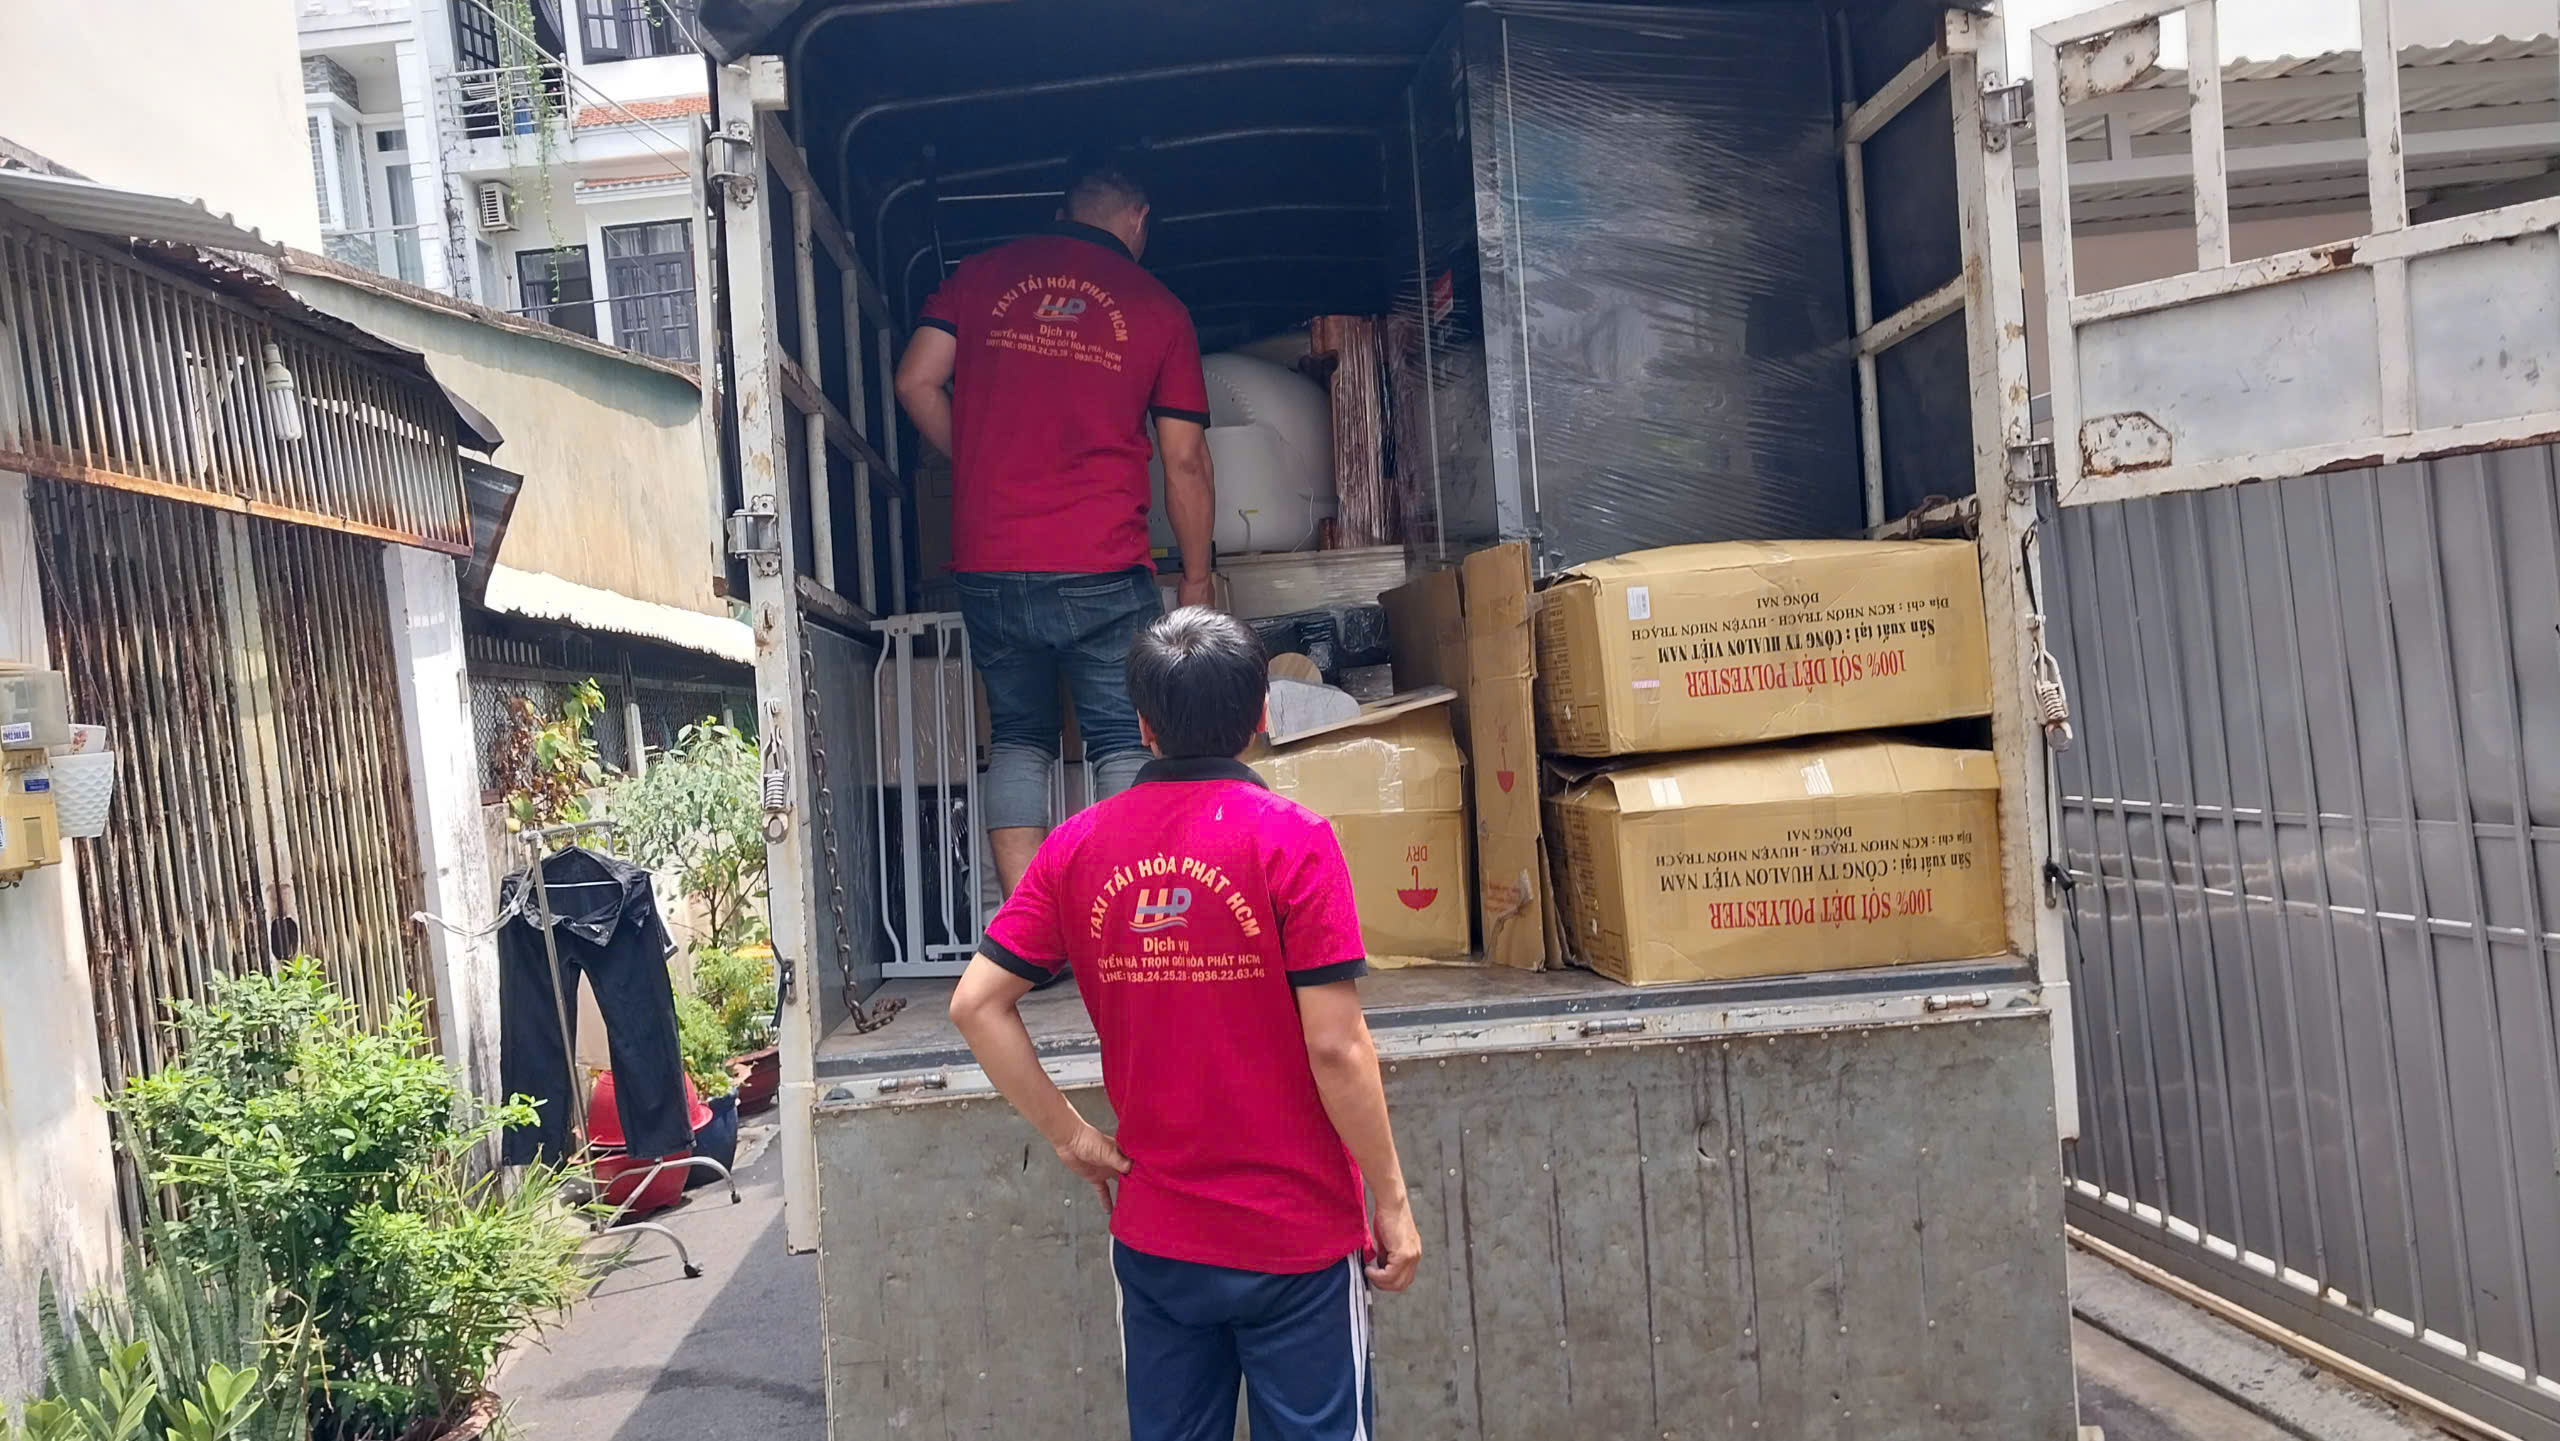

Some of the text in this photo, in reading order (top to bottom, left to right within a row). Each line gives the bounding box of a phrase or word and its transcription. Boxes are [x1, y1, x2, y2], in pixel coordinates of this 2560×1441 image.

[992, 288, 1018, 318] TAXI
[1018, 274, 1043, 294] TẢI
[1080, 280, 1115, 308] PHÁT
[1108, 309, 1128, 342] HCM
[1037, 294, 1087, 316] HP
[1040, 324, 1078, 340] Dịch vụ
[1756, 596, 1778, 608] NAI
[1868, 604, 1896, 616] KCN
[1779, 610, 1823, 626] TRẠCH
[1826, 608, 1864, 622] NHƠN
[1632, 626, 1678, 640] TRẠCH
[1681, 622, 1718, 636] NHƠN
[1722, 617, 1766, 632] HUYỆN
[1854, 622, 1872, 644] tại
[1728, 636, 1780, 656] HUALON
[1786, 633, 1802, 650] TY
[1806, 629, 1842, 651] CÔNG
[1658, 647, 1687, 663] NAM
[1692, 638, 1724, 664] VIỆT
[1832, 650, 1863, 687] SỢI
[1866, 650, 1906, 677] 100%
[1685, 662, 1788, 698] POLYESTER
[1787, 829, 1810, 842] NAI
[1902, 836, 1928, 849] KCN
[1406, 845, 1428, 862] DRY
[1752, 846, 1799, 860] HUYỆN
[1811, 842, 1858, 856] TRẠCH
[1860, 839, 1898, 852] NHƠN
[1656, 852, 1705, 866] TRẠCH
[1706, 850, 1747, 864] NHƠN
[1901, 853, 1917, 875] tại
[1702, 867, 1741, 892] VIỆT
[1746, 866, 1813, 886] HUALON
[1818, 864, 1840, 881] TY
[1842, 860, 1888, 882] CÔNG
[1661, 875, 1698, 892] NAM
[1090, 852, 1261, 940] TAXI TẢI HÒA PHÁT HCM
[1896, 888, 1933, 916] 100%
[1134, 888, 1192, 923] HP
[1709, 896, 1815, 930] POLYESTER
[1862, 887, 1891, 924] SỢI
[1143, 936, 1189, 955] Dịch vụ
[1141, 956, 1169, 968] TRỌN
[1208, 954, 1234, 966] PHÁT
[1238, 954, 1260, 965] HCM
